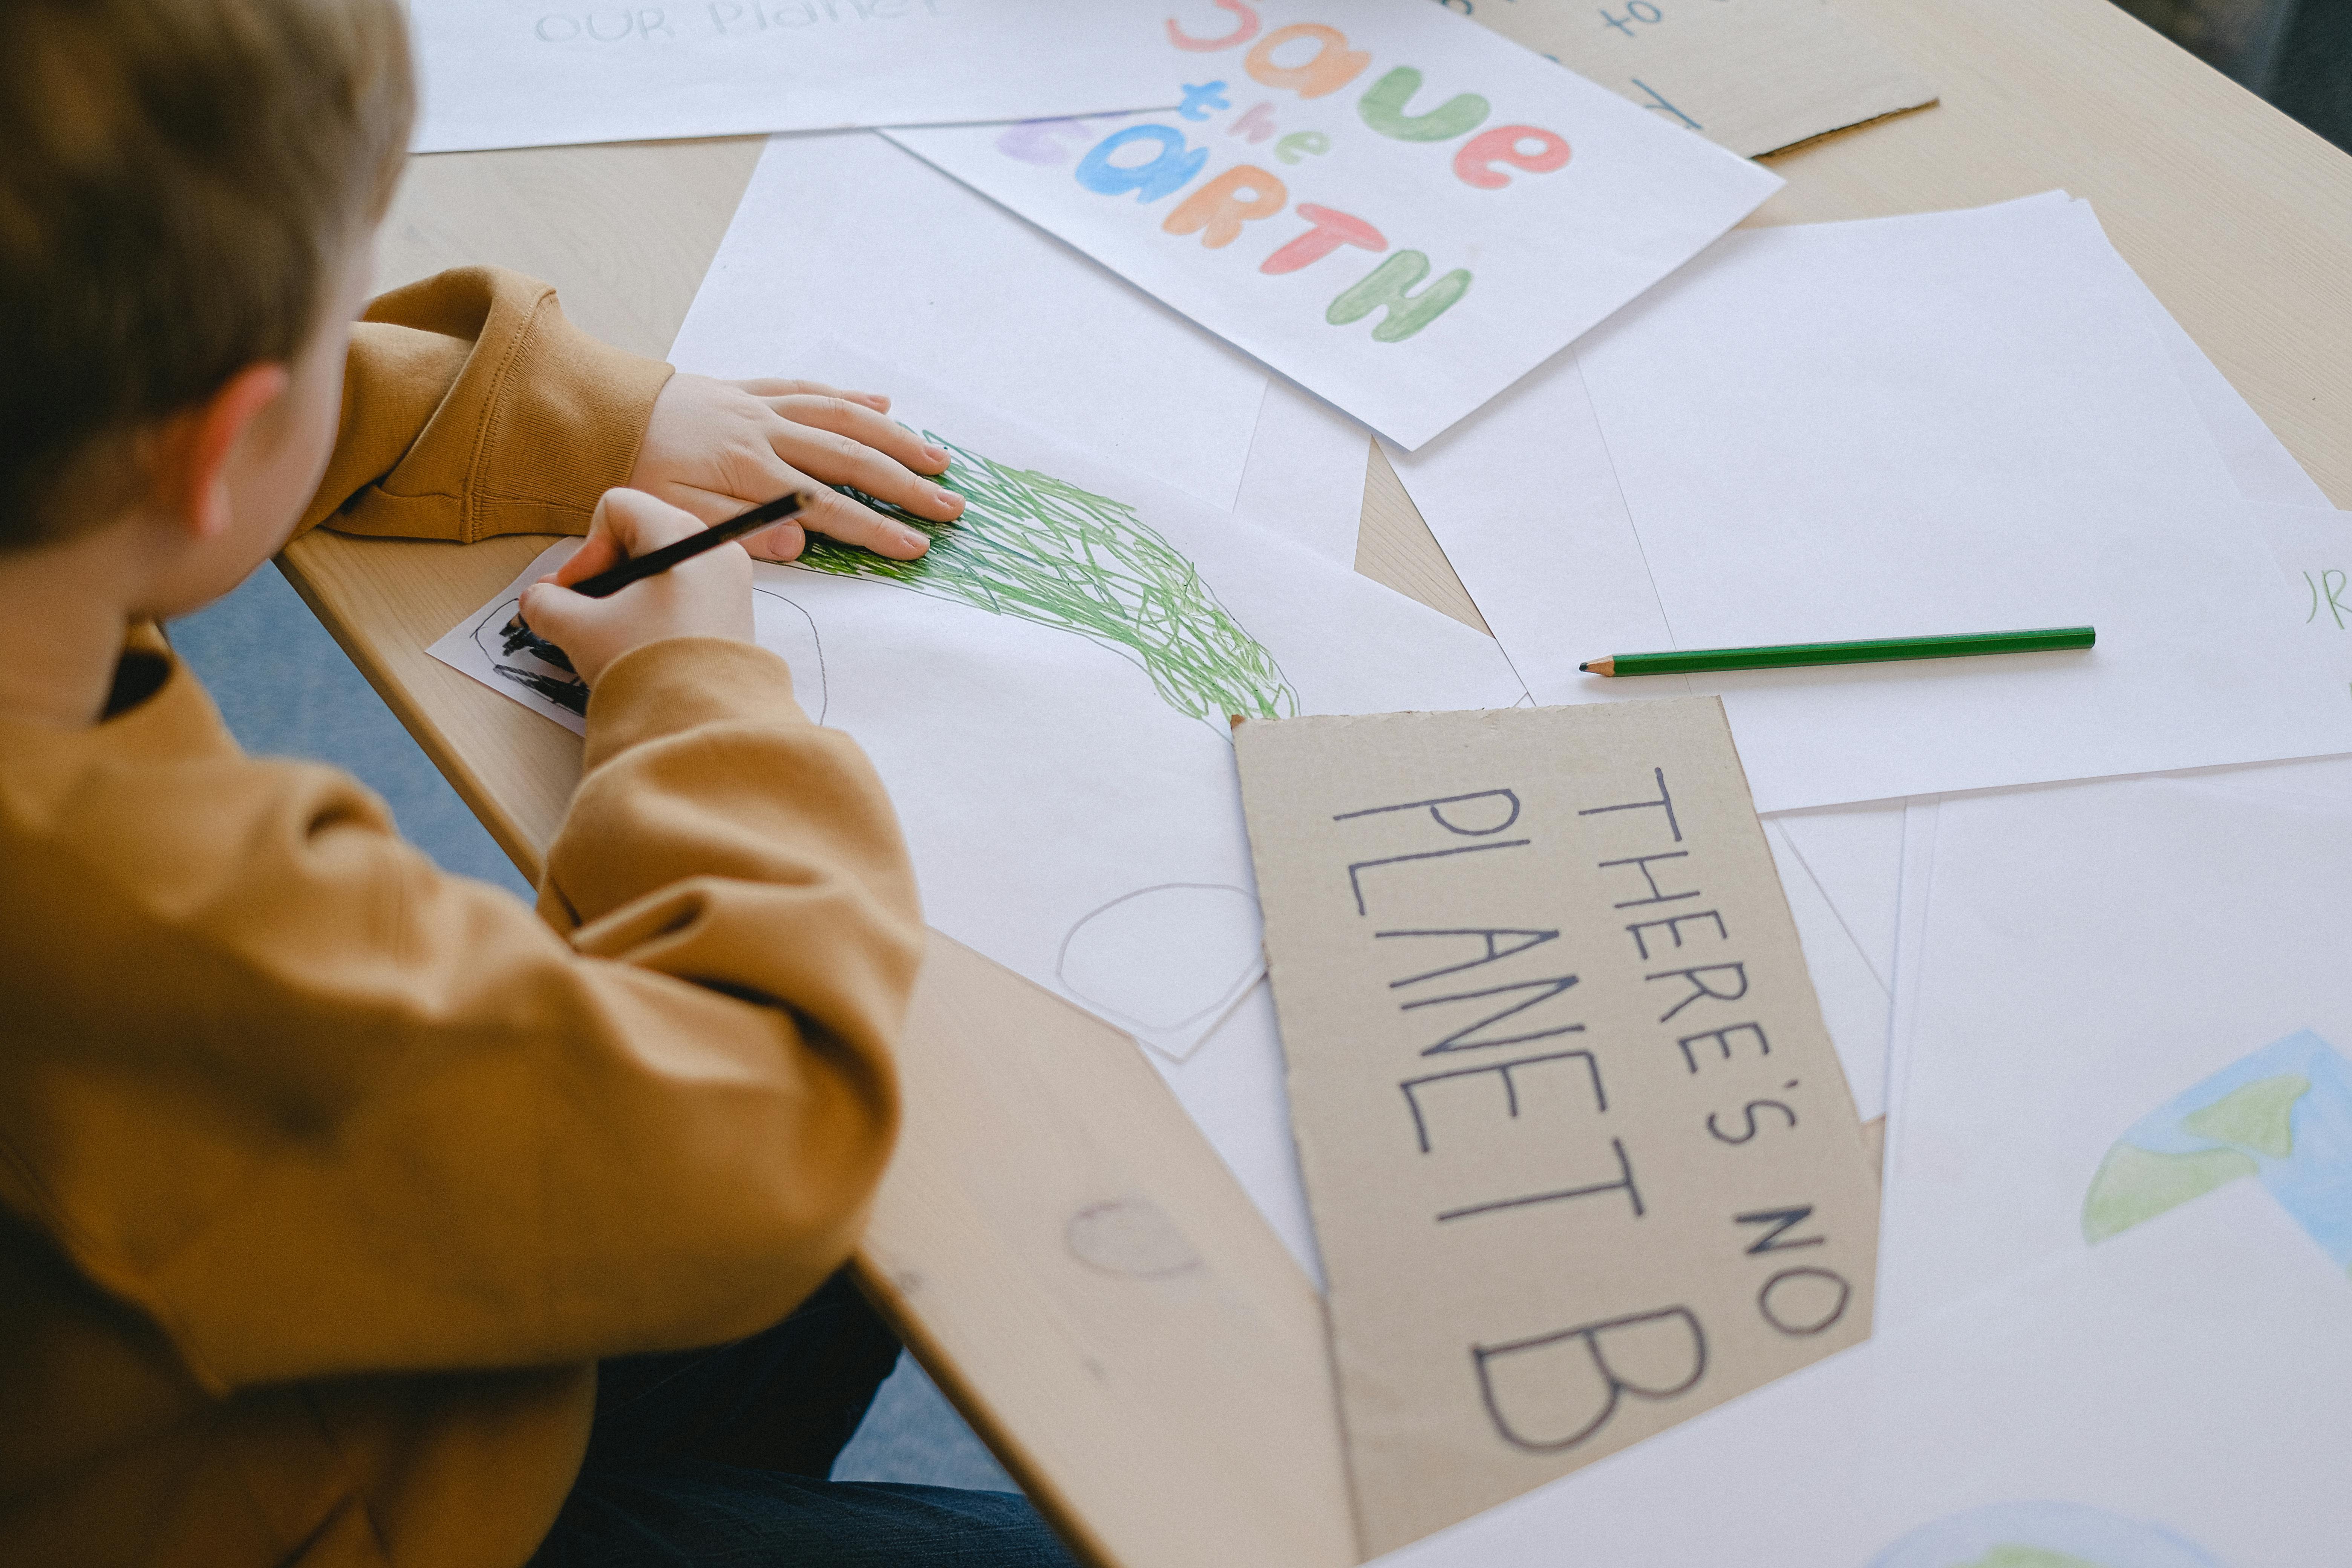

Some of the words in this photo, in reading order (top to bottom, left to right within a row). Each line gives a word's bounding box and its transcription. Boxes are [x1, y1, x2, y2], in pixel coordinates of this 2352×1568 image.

[534, 8, 675, 42] OUR
[1178, 80, 1331, 165] the
[1332, 788, 1646, 1223] PLANET
[1578, 767, 1799, 1145] THERE'S
[1734, 1205, 1851, 1336] NO
[1472, 1304, 1707, 1453] B
